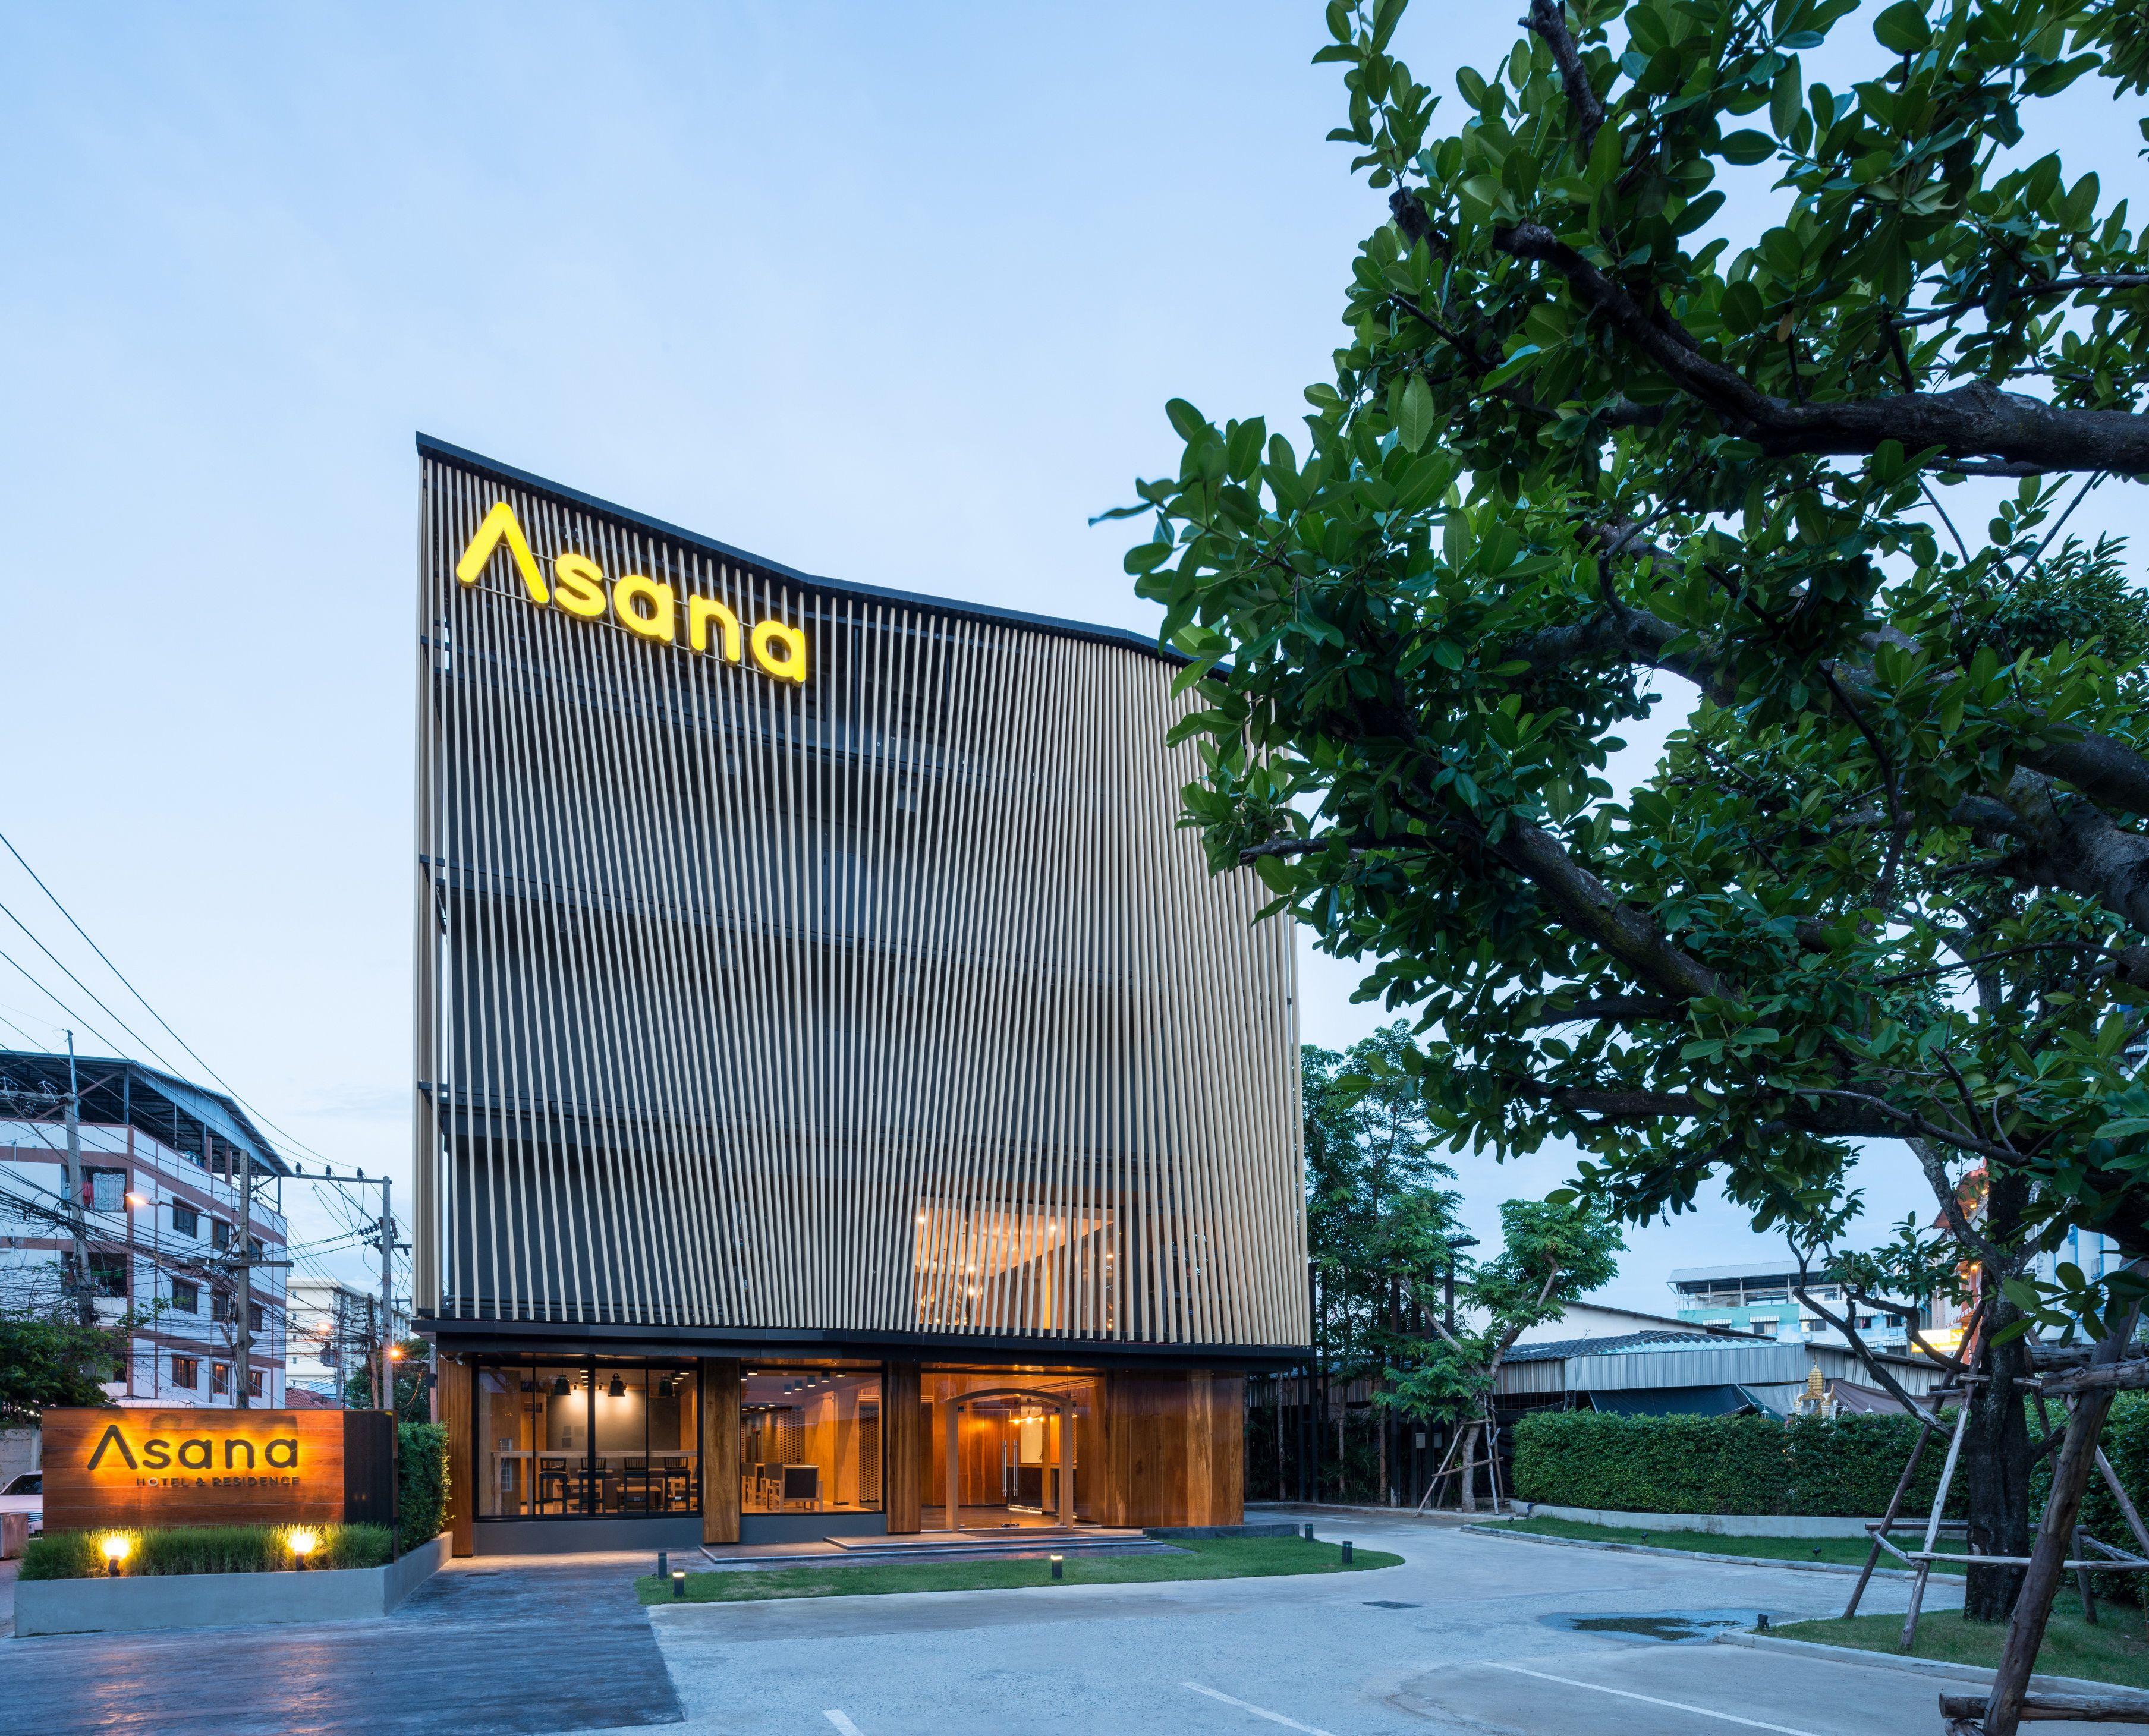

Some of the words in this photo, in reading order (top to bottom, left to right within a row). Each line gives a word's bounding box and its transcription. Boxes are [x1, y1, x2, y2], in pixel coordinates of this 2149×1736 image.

[456, 502, 806, 685] Asana
[87, 1424, 298, 1470] Asana
[136, 1477, 189, 1486] HOTEL
[196, 1477, 205, 1486] &
[212, 1476, 300, 1486] RESIDENCE
